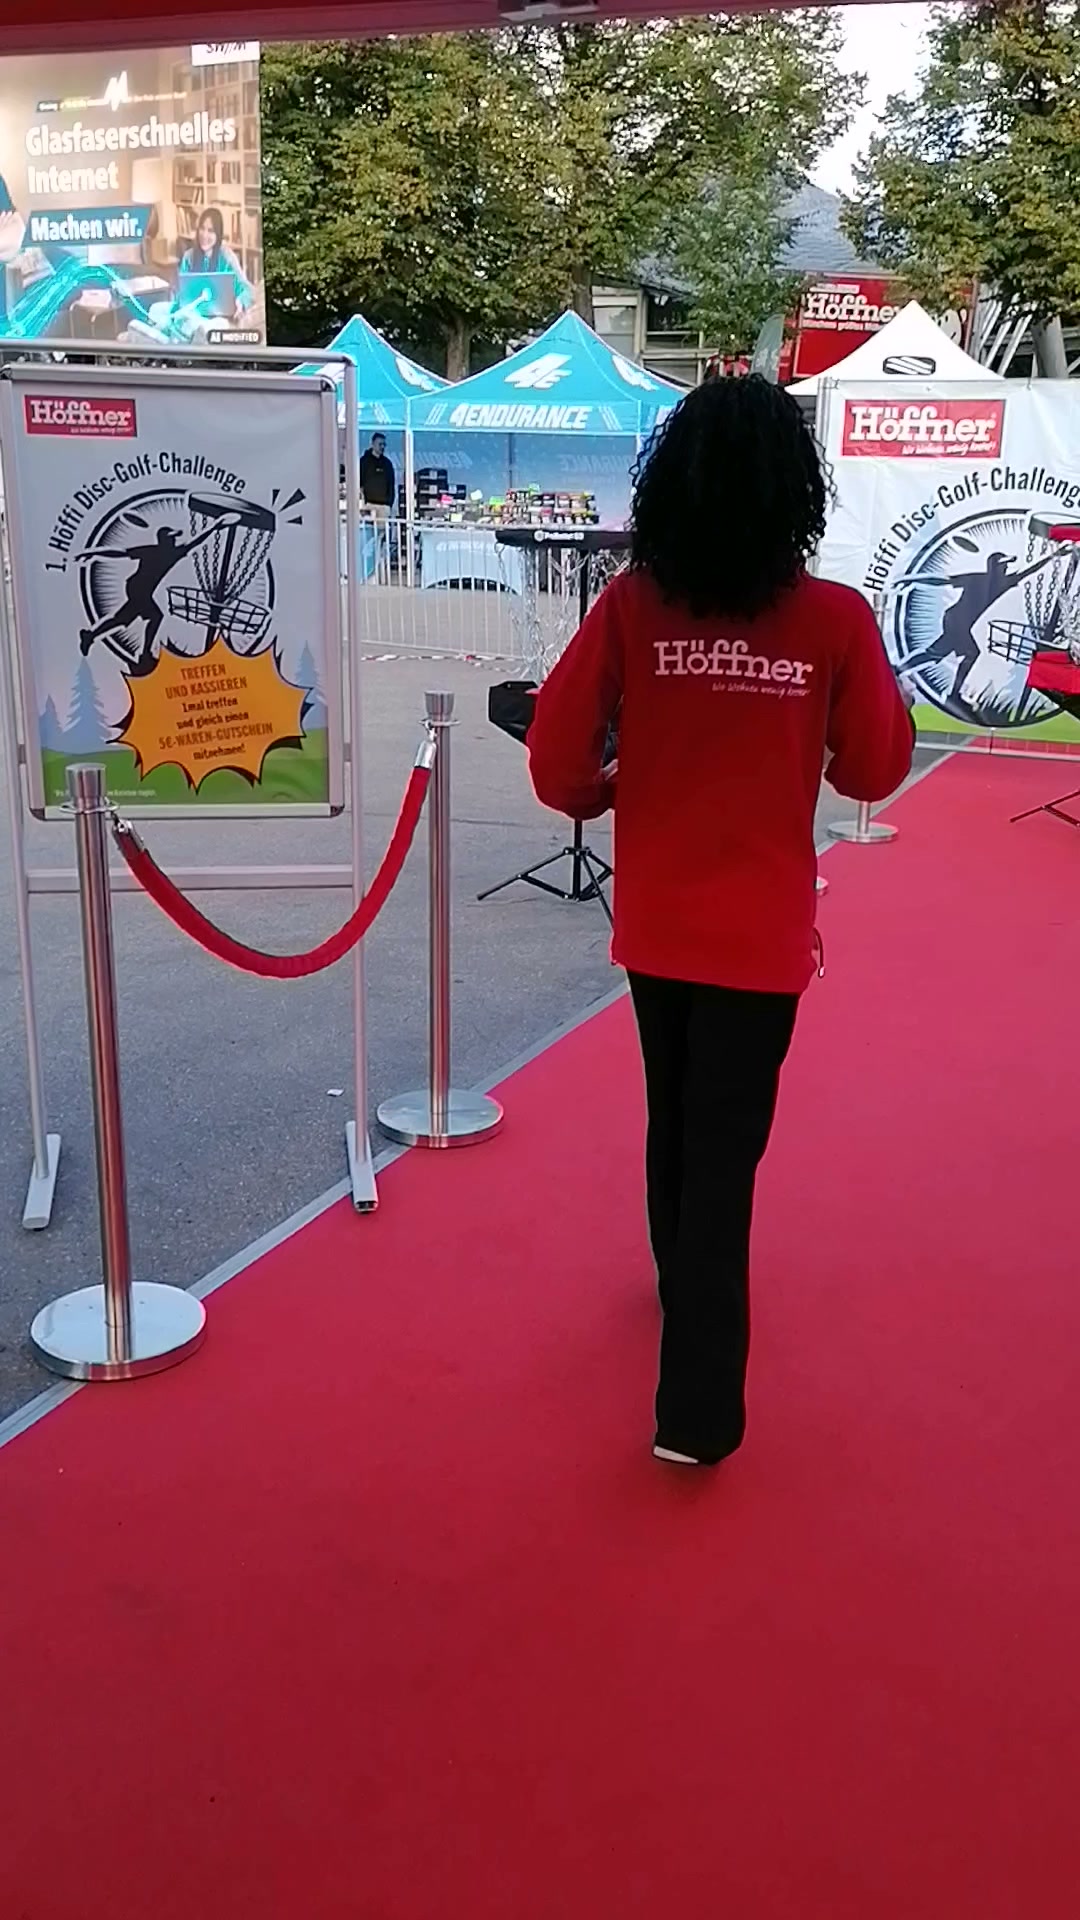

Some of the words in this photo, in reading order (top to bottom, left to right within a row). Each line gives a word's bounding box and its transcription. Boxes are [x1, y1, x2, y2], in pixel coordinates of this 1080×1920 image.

[25, 111, 236, 156] Glasfaserschnelles
[28, 160, 119, 194] Internet
[31, 213, 103, 241] Machen
[105, 212, 143, 238] wir.
[30, 400, 132, 427] Höffner
[449, 402, 593, 430] 4ENDURANCE
[849, 405, 997, 443] Höffner
[73, 451, 246, 511] Disc-Golf-Challenge
[48, 504, 85, 553] Höffi
[863, 538, 900, 592] Höffi
[890, 466, 1080, 543] Disc-Golf-Challeng
[45, 557, 68, 573] 1.
[181, 664, 226, 680] TREFFEN
[653, 639, 814, 684] Höffner
[165, 687, 188, 699] UND
[190, 677, 247, 695] KASSIEREN
[206, 697, 238, 709] treffen
